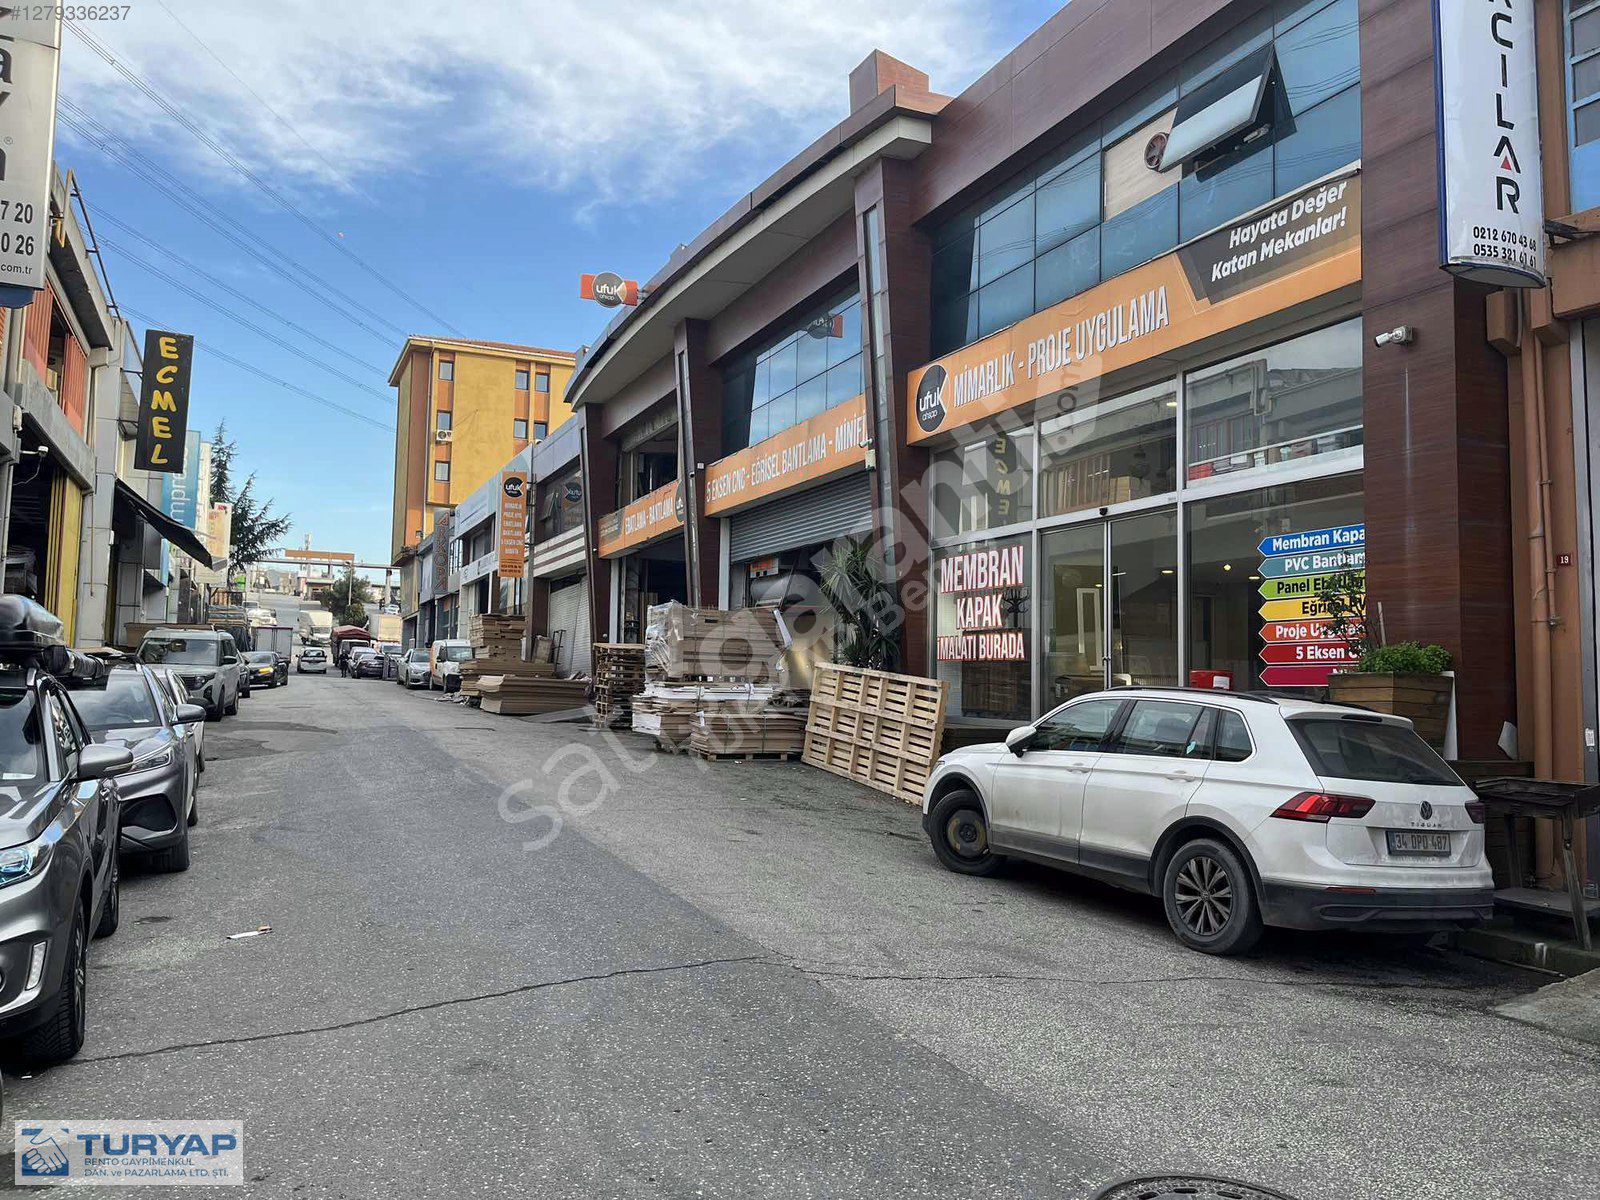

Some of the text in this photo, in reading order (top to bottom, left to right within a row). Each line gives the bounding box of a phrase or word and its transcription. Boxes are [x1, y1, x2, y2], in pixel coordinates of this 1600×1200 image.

[14, 203, 33, 224] 20
[1229, 181, 1347, 249] Hayata Değer
[15, 234, 35, 256] 26
[1211, 206, 1347, 283] Katan Mekanlar!
[1473, 226, 1499, 242] 0212
[1501, 230, 1517, 245] 670
[1519, 235, 1527, 248] 43
[1473, 243, 1499, 258] 0535
[1501, 247, 1517, 262] 321
[596, 283, 619, 296] ufuk
[953, 351, 1016, 408] MİMARLIK
[1027, 326, 1072, 379] PROJE
[1075, 285, 1170, 360] UYGULAMA
[151, 336, 179, 465] ECMEL
[919, 386, 941, 411] ufuk
[782, 433, 827, 474] BANTLAMA
[1272, 533, 1330, 551] Membran
[941, 545, 1024, 593] MEMBRAN
[1284, 556, 1309, 572] PVC
[1277, 579, 1310, 594] Panel
[956, 594, 1003, 629] KAPAK
[1275, 623, 1307, 640] Proje
[979, 633, 1025, 659] BURADA
[1296, 646, 1303, 660] 5
[1306, 645, 1345, 660] Eksen
[1395, 834, 1408, 850] 34
